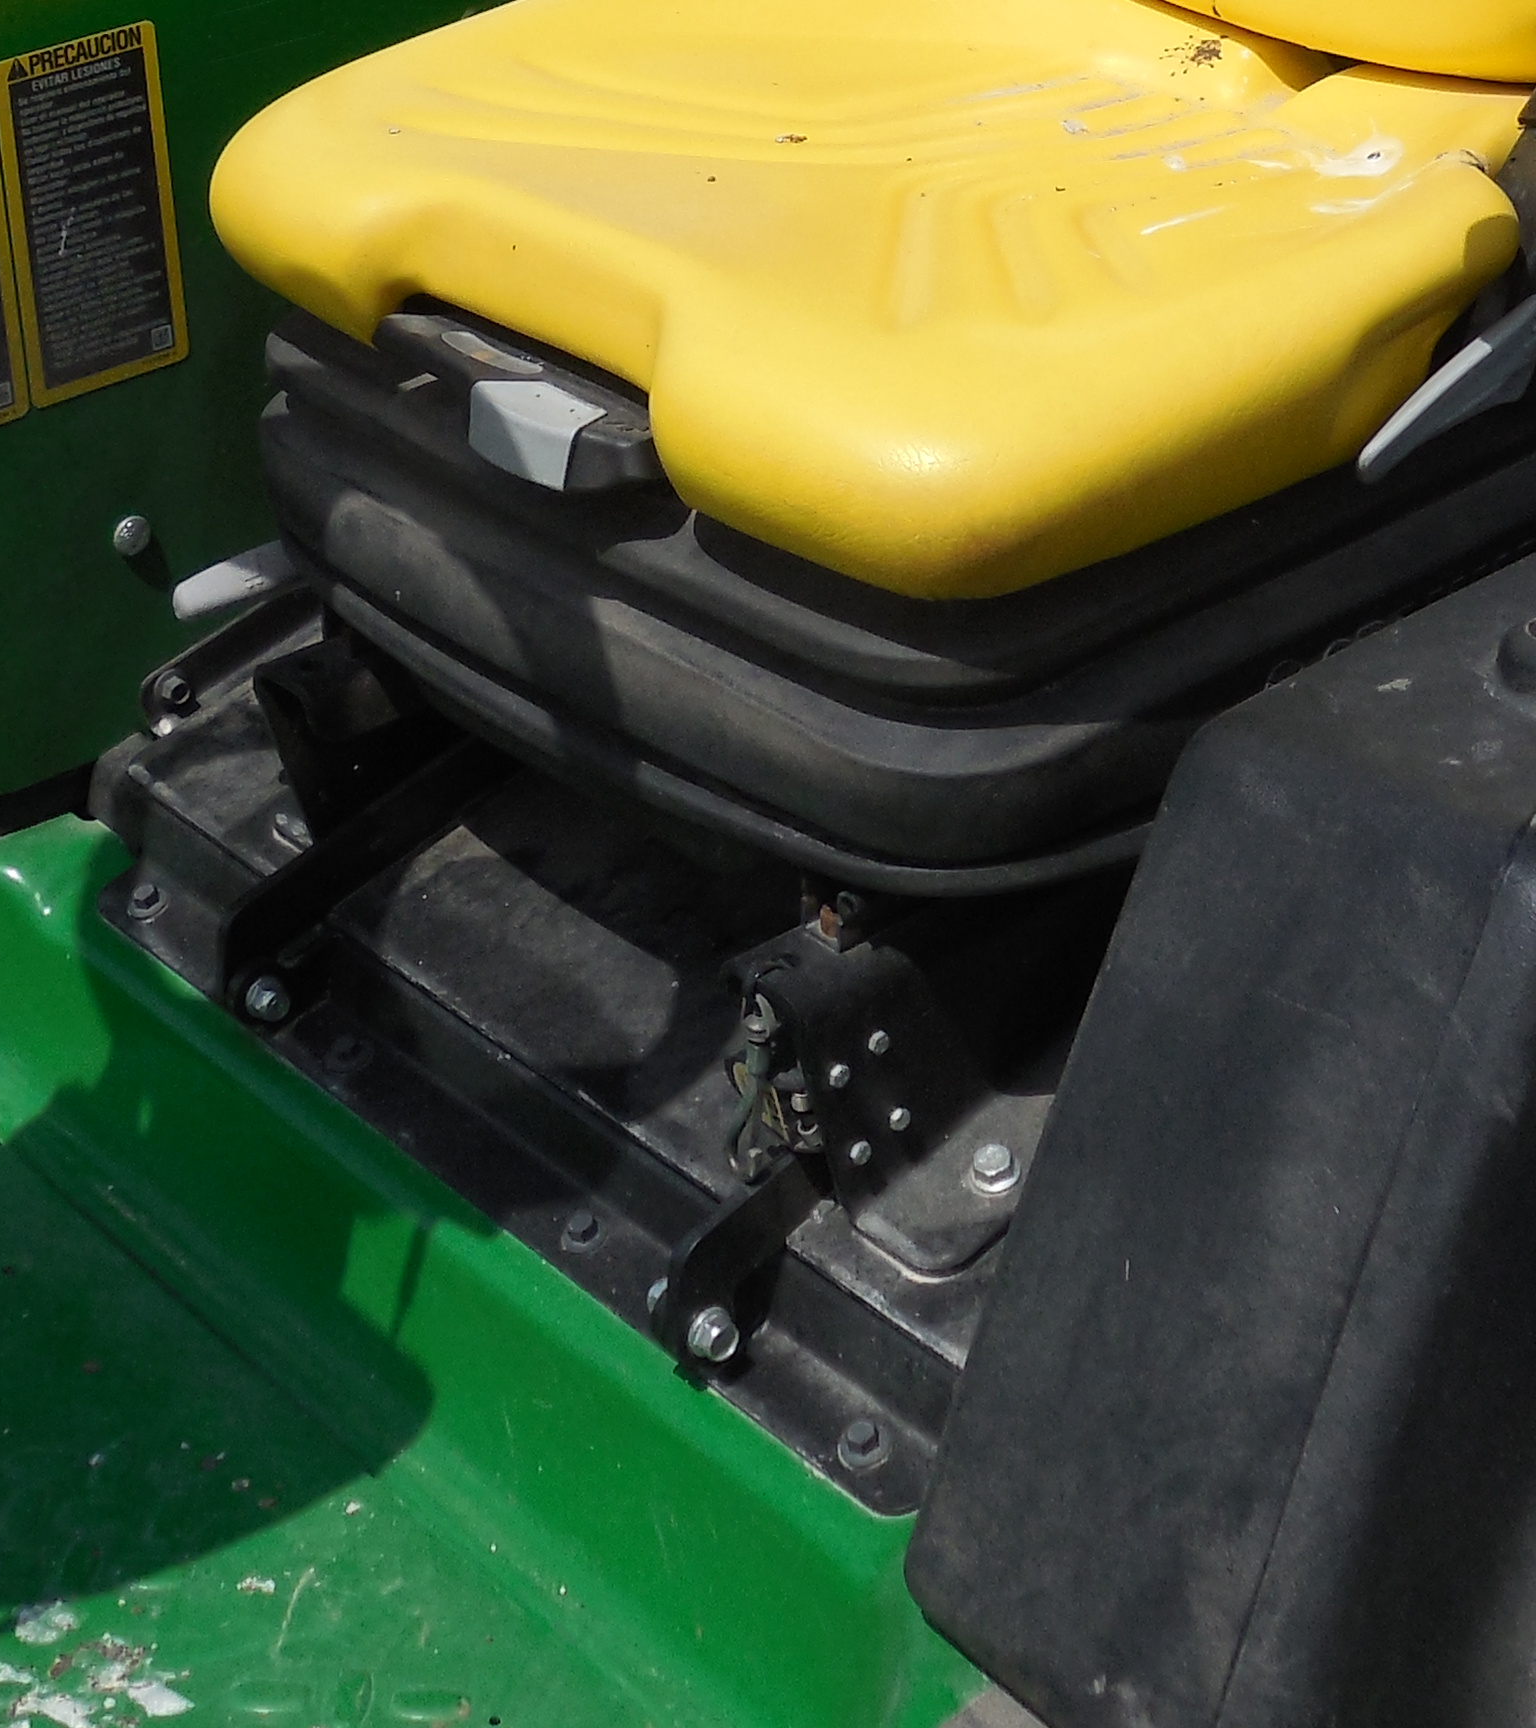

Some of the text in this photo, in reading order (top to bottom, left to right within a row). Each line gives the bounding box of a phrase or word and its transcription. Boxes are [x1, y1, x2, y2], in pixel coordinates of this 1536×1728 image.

[28, 23, 142, 76] PRECAUCION
[31, 55, 121, 92] EVITAR LESIONES
